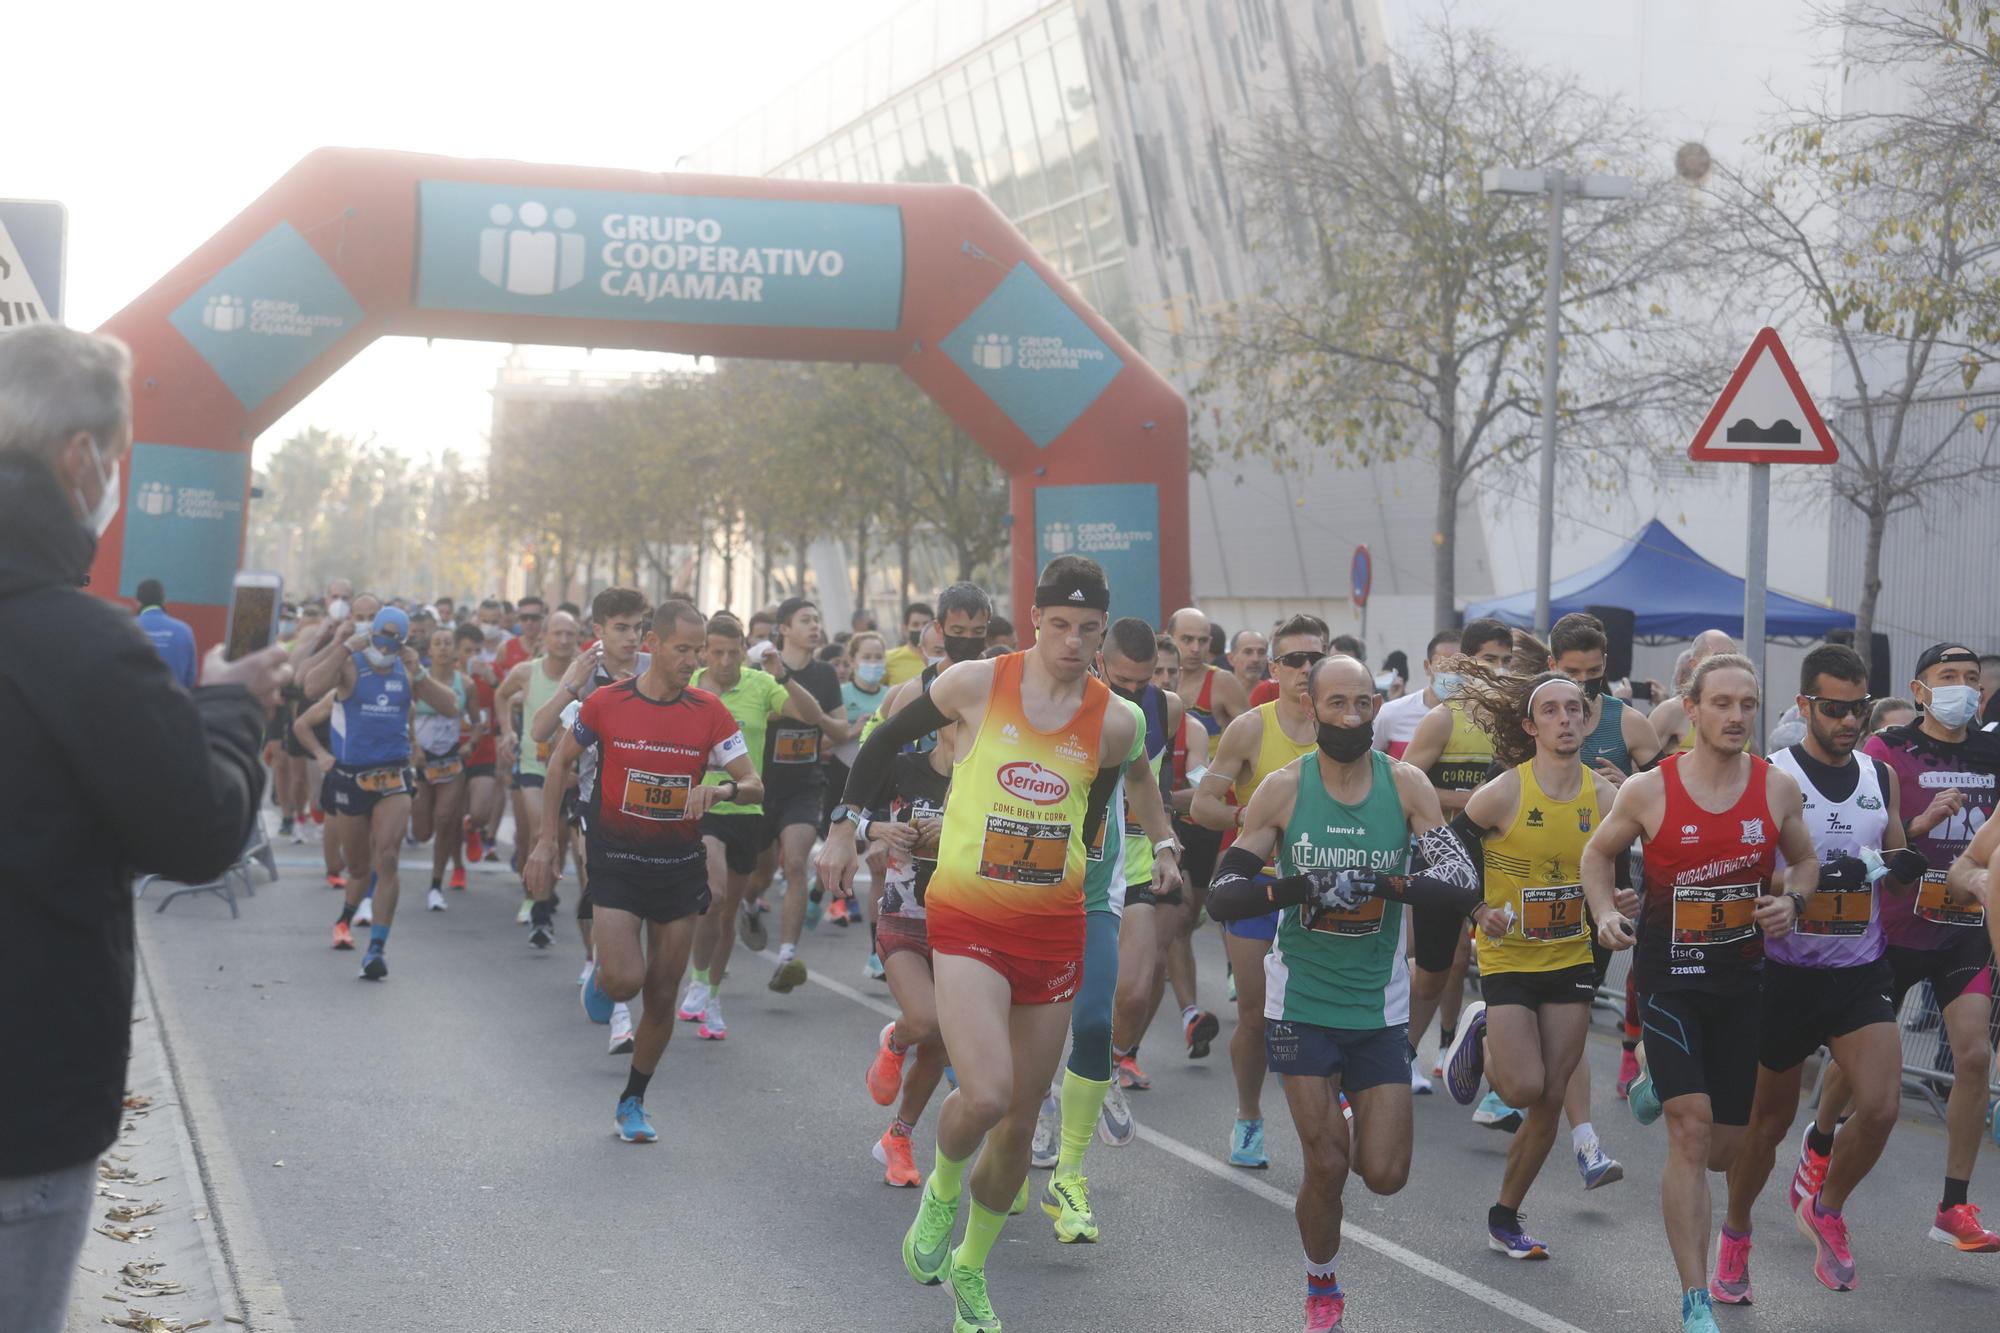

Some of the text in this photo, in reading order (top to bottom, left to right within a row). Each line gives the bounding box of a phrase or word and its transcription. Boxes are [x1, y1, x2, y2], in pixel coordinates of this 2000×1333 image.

[602, 213, 722, 244] GRUPO
[601, 240, 844, 277] COOPERATIVO
[600, 271, 763, 303] CAJAMAR
[252, 299, 300, 314] GRUPO
[1018, 336, 1062, 348] GRUPO
[1018, 347, 1104, 361] COOPERATIVO
[1018, 358, 1080, 370] CAJAMAR
[1078, 523, 1116, 532] GRUPO
[1078, 531, 1152, 541] COOPERATIVO
[1078, 540, 1130, 551] CAJAMAR
[1055, 745, 1088, 761] SERRANO
[1004, 768, 1064, 796] Serrano
[645, 787, 672, 805] 138
[993, 802, 1067, 822] COME BIEN Y CORRE
[989, 818, 1002, 827] 10K
[1003, 820, 1016, 829] PAS
[1016, 823, 1030, 833] RAS
[1327, 825, 1355, 834] luanvi
[1024, 839, 1035, 860] 7
[1292, 845, 1404, 870] ALEJANDRO SANZ
[1549, 902, 1566, 921] 12
[1711, 903, 1724, 923] 5
[1833, 895, 1843, 914] 1
